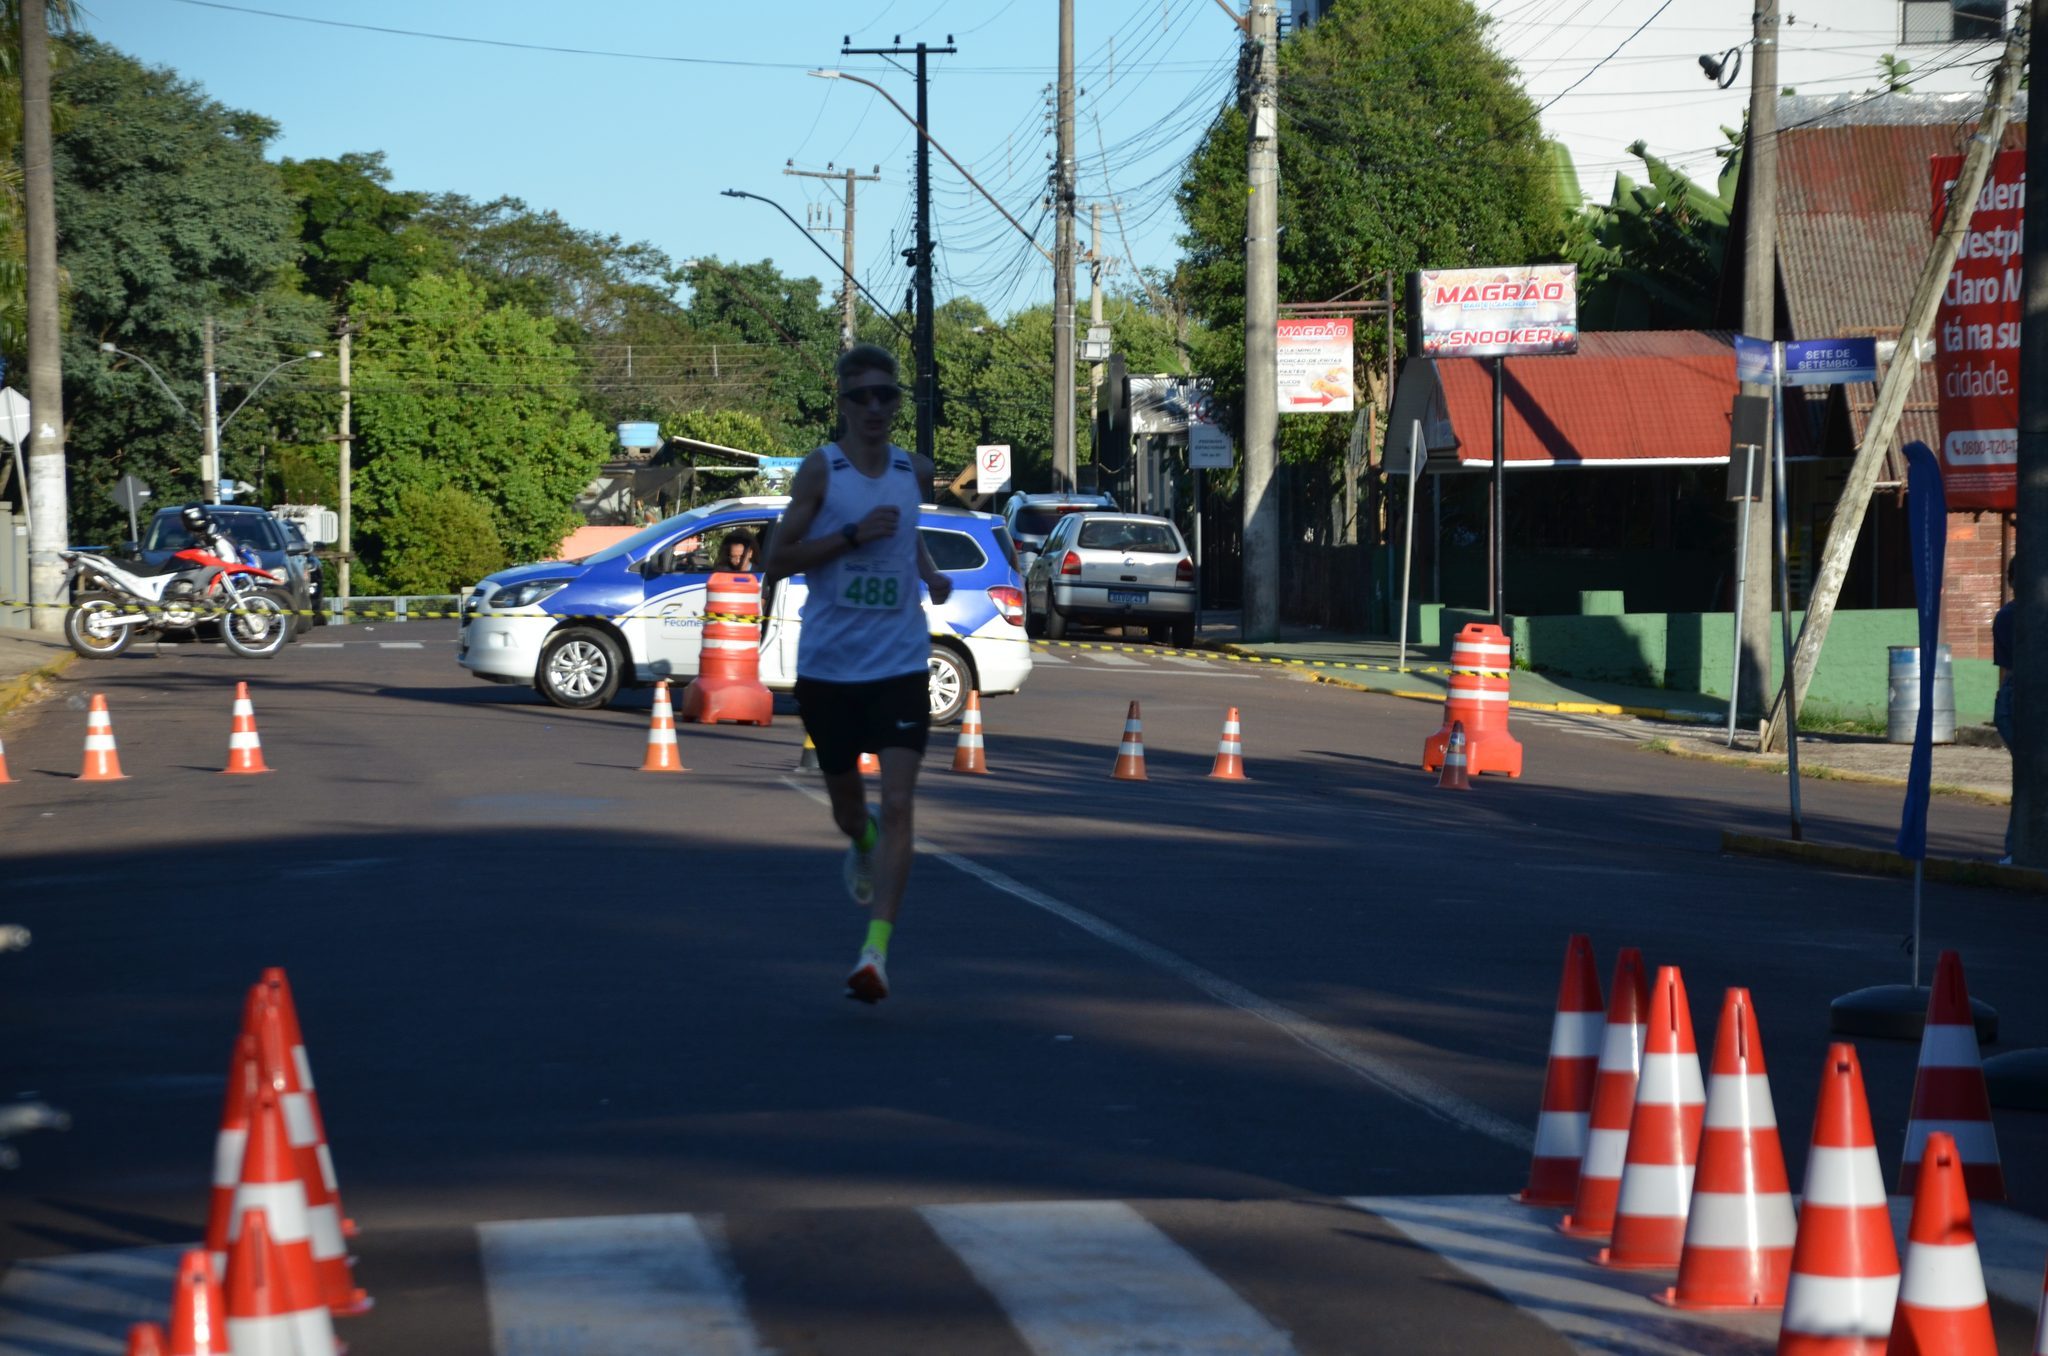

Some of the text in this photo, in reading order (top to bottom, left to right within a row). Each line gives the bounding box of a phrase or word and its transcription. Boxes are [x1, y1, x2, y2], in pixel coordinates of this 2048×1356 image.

[1436, 276, 1563, 304] MAGRÃO
[1944, 270, 2000, 306] Claro
[1278, 322, 1347, 337] MAGRÃO
[1450, 329, 1553, 345] SNOOKER
[1944, 316, 1963, 352] tá
[1968, 322, 1993, 350] na
[1798, 359, 1857, 370] SETEMBRO
[1805, 348, 1850, 360] SETE DE
[1946, 359, 2014, 398] cidade.
[844, 576, 898, 606] 488
